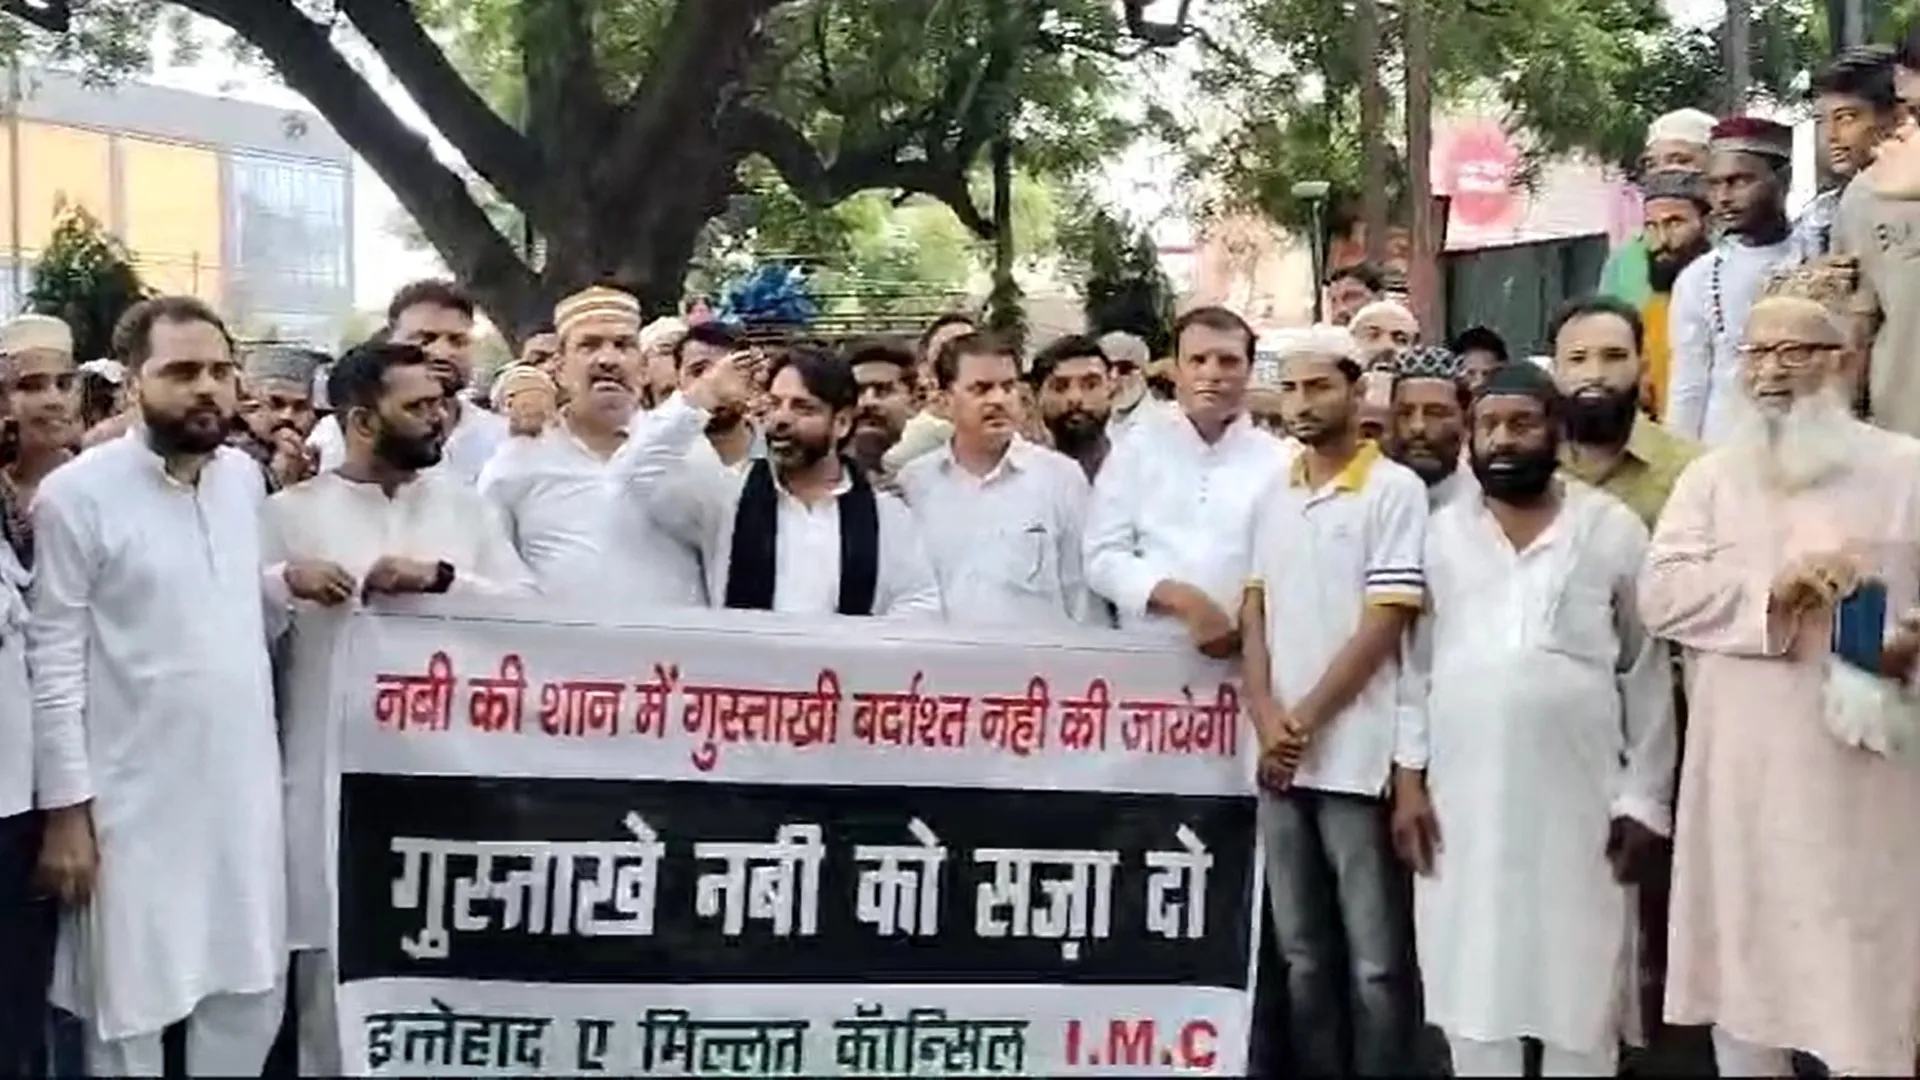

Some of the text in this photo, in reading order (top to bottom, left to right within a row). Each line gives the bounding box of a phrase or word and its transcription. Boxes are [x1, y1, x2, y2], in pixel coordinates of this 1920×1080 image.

[375, 652, 455, 731] नबी
[469, 655, 526, 733] की
[541, 682, 625, 736] शान
[636, 664, 679, 738] में
[682, 669, 840, 771] गुस्ताखी
[853, 672, 971, 747] बर्दाश्त
[981, 677, 1049, 755] नही
[1060, 679, 1110, 751] की
[390, 810, 1213, 961] गुस्ताखे नबी को सज़ा दो
[576, 1019, 614, 1070] ए
[638, 1009, 809, 1073] मिल्लत
[1064, 1019, 1218, 1067] I.M.C
